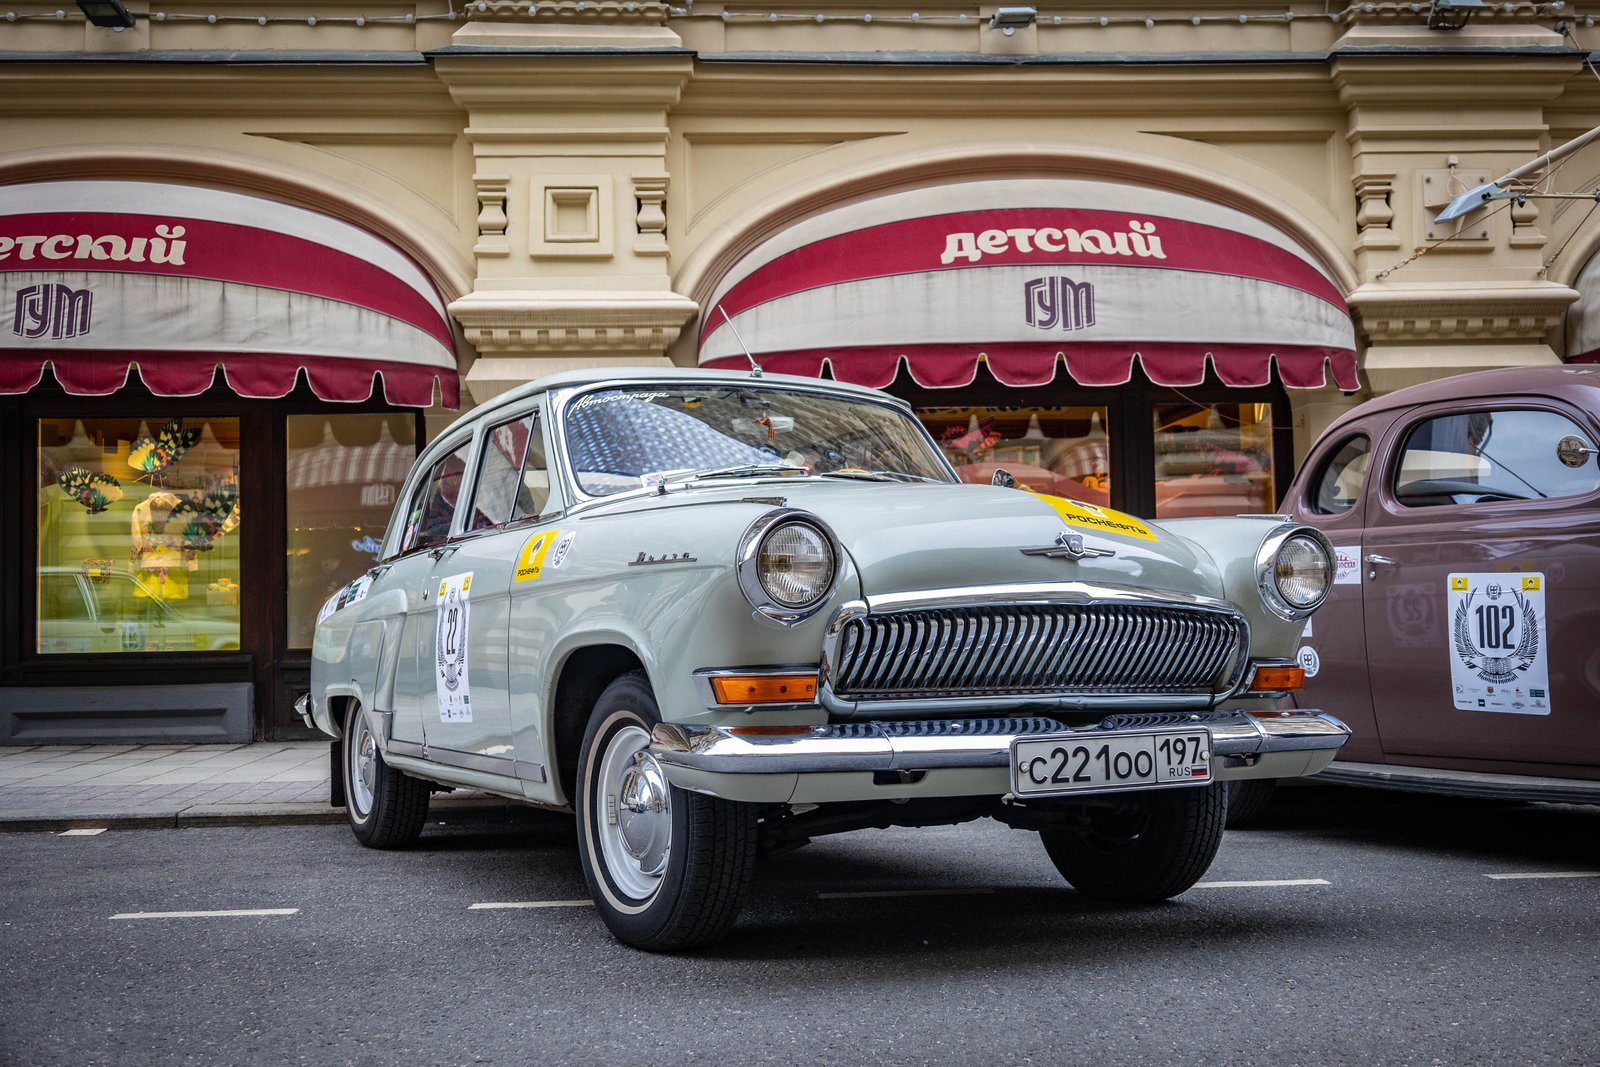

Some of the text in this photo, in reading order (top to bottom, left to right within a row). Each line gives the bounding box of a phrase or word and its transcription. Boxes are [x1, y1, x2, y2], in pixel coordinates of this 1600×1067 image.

[940, 219, 1167, 265] детский
[13, 283, 93, 340] ГУМ
[1024, 275, 1096, 331] ГУМ
[1065, 513, 1148, 535] РОСНЕФТЬ
[446, 608, 459, 655] 22
[1475, 604, 1516, 650] 102
[1159, 736, 1201, 766] 197
[1169, 767, 1191, 777] RUS
